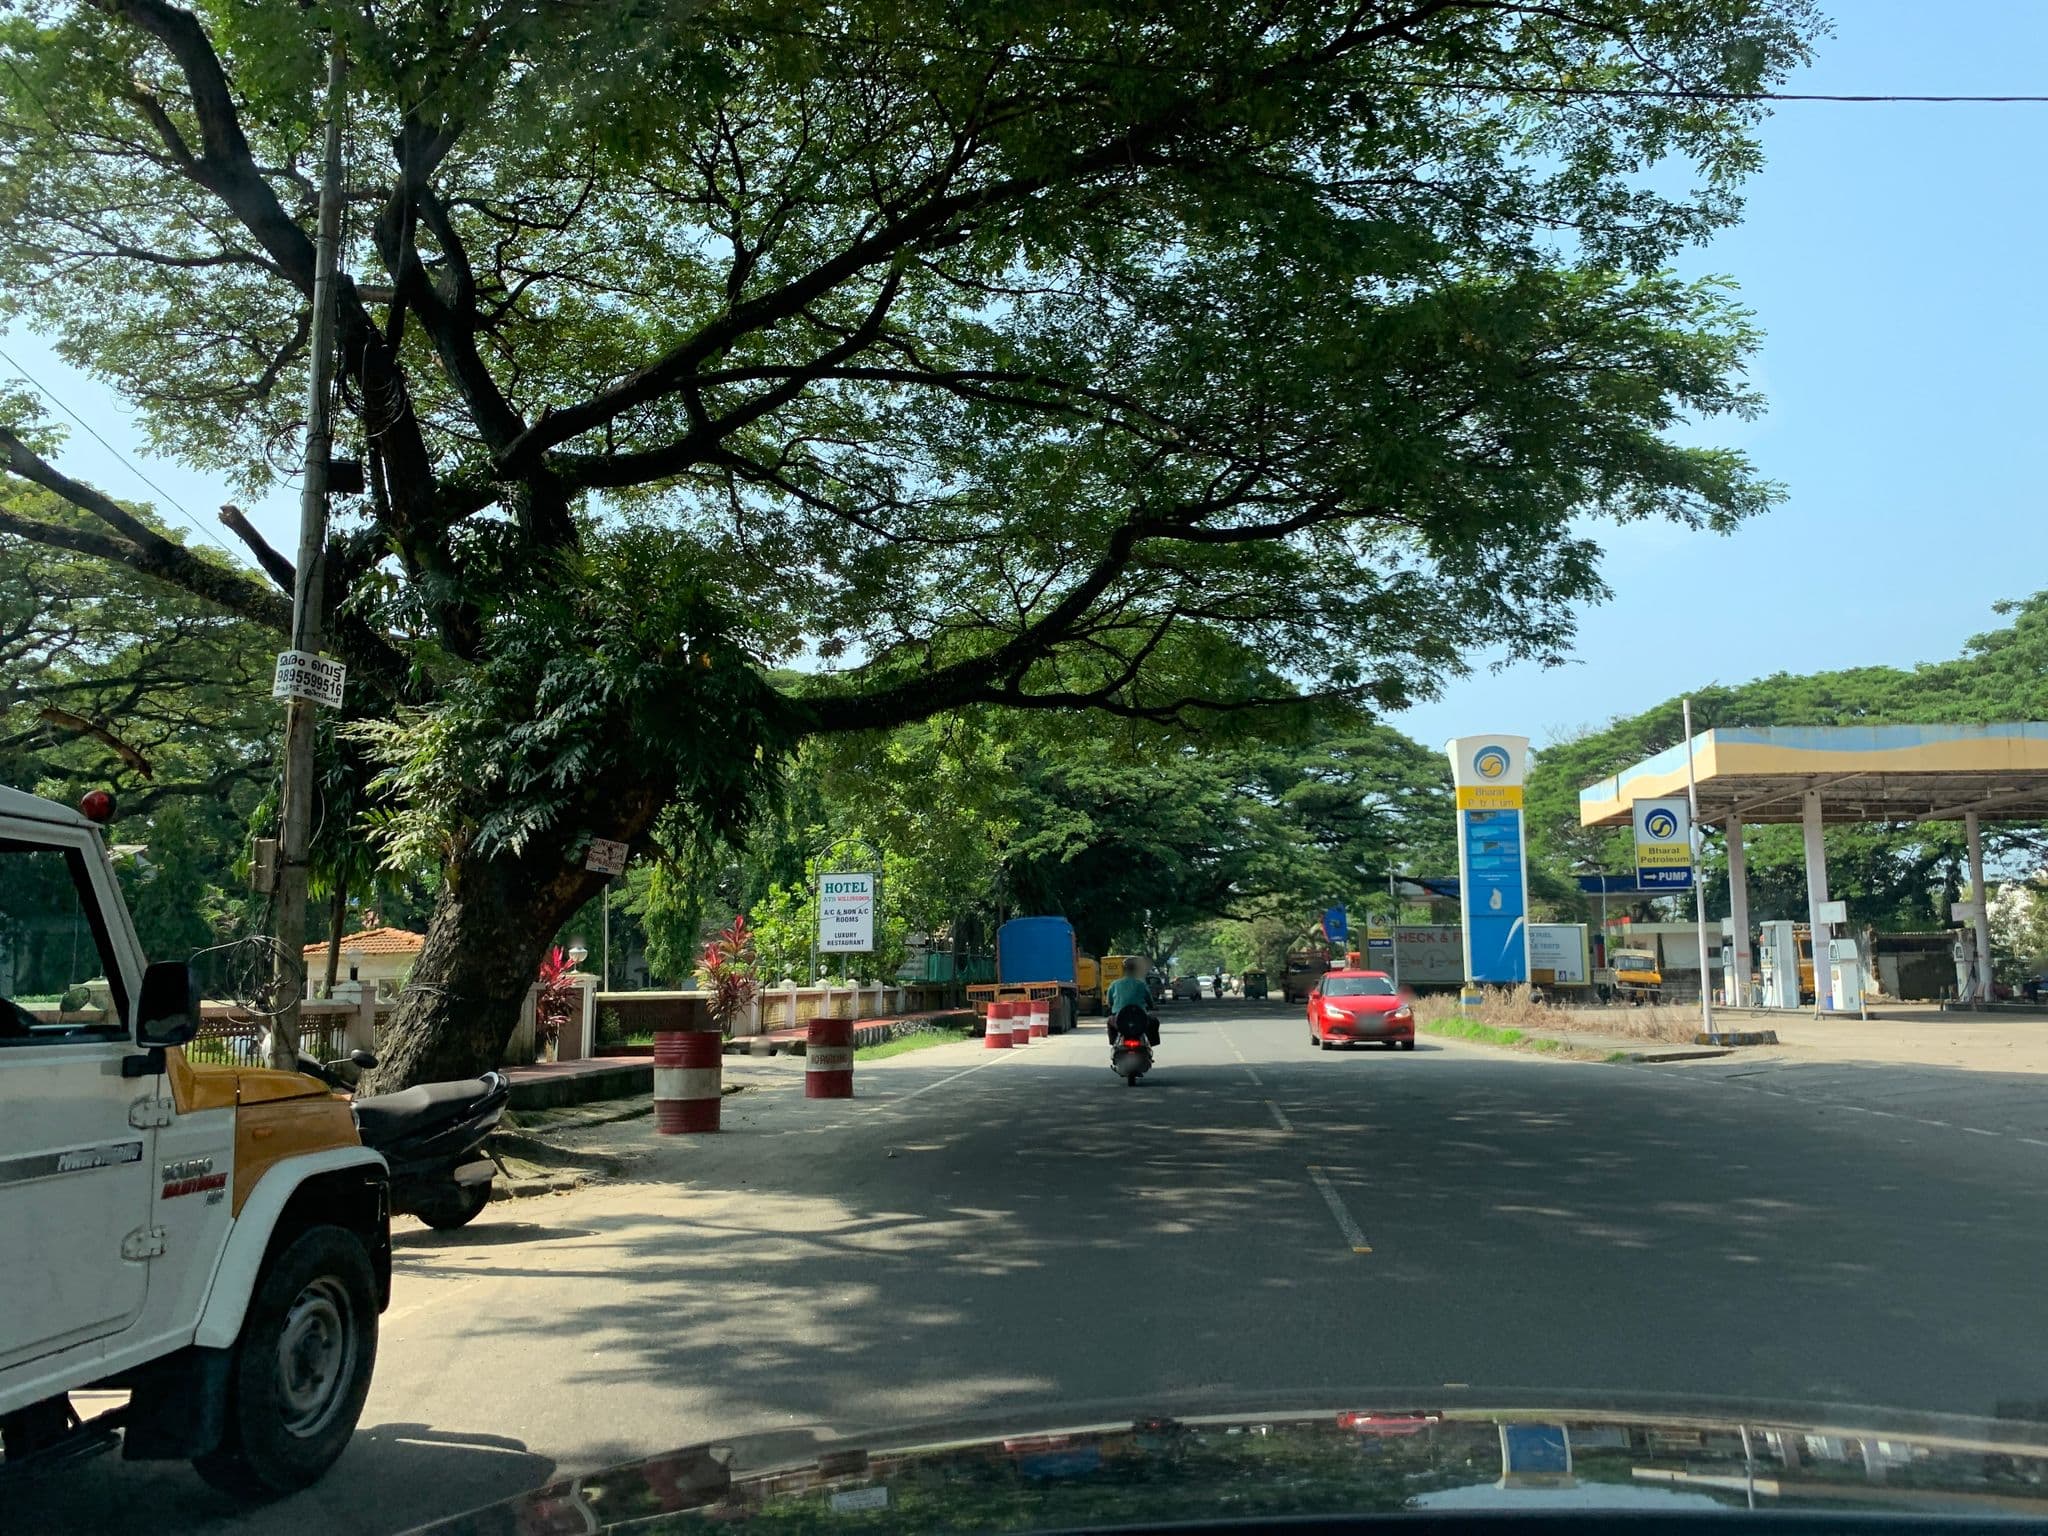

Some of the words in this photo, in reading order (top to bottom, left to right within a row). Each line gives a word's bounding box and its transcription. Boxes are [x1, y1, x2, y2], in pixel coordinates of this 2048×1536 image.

[277, 668, 342, 697] 9895599516
[1648, 847, 1680, 855] Bharat
[1640, 856, 1689, 864] Petroleum
[1658, 871, 1688, 881] PUMP
[825, 882, 868, 894] HOTEL
[1398, 932, 1436, 943] HECK
